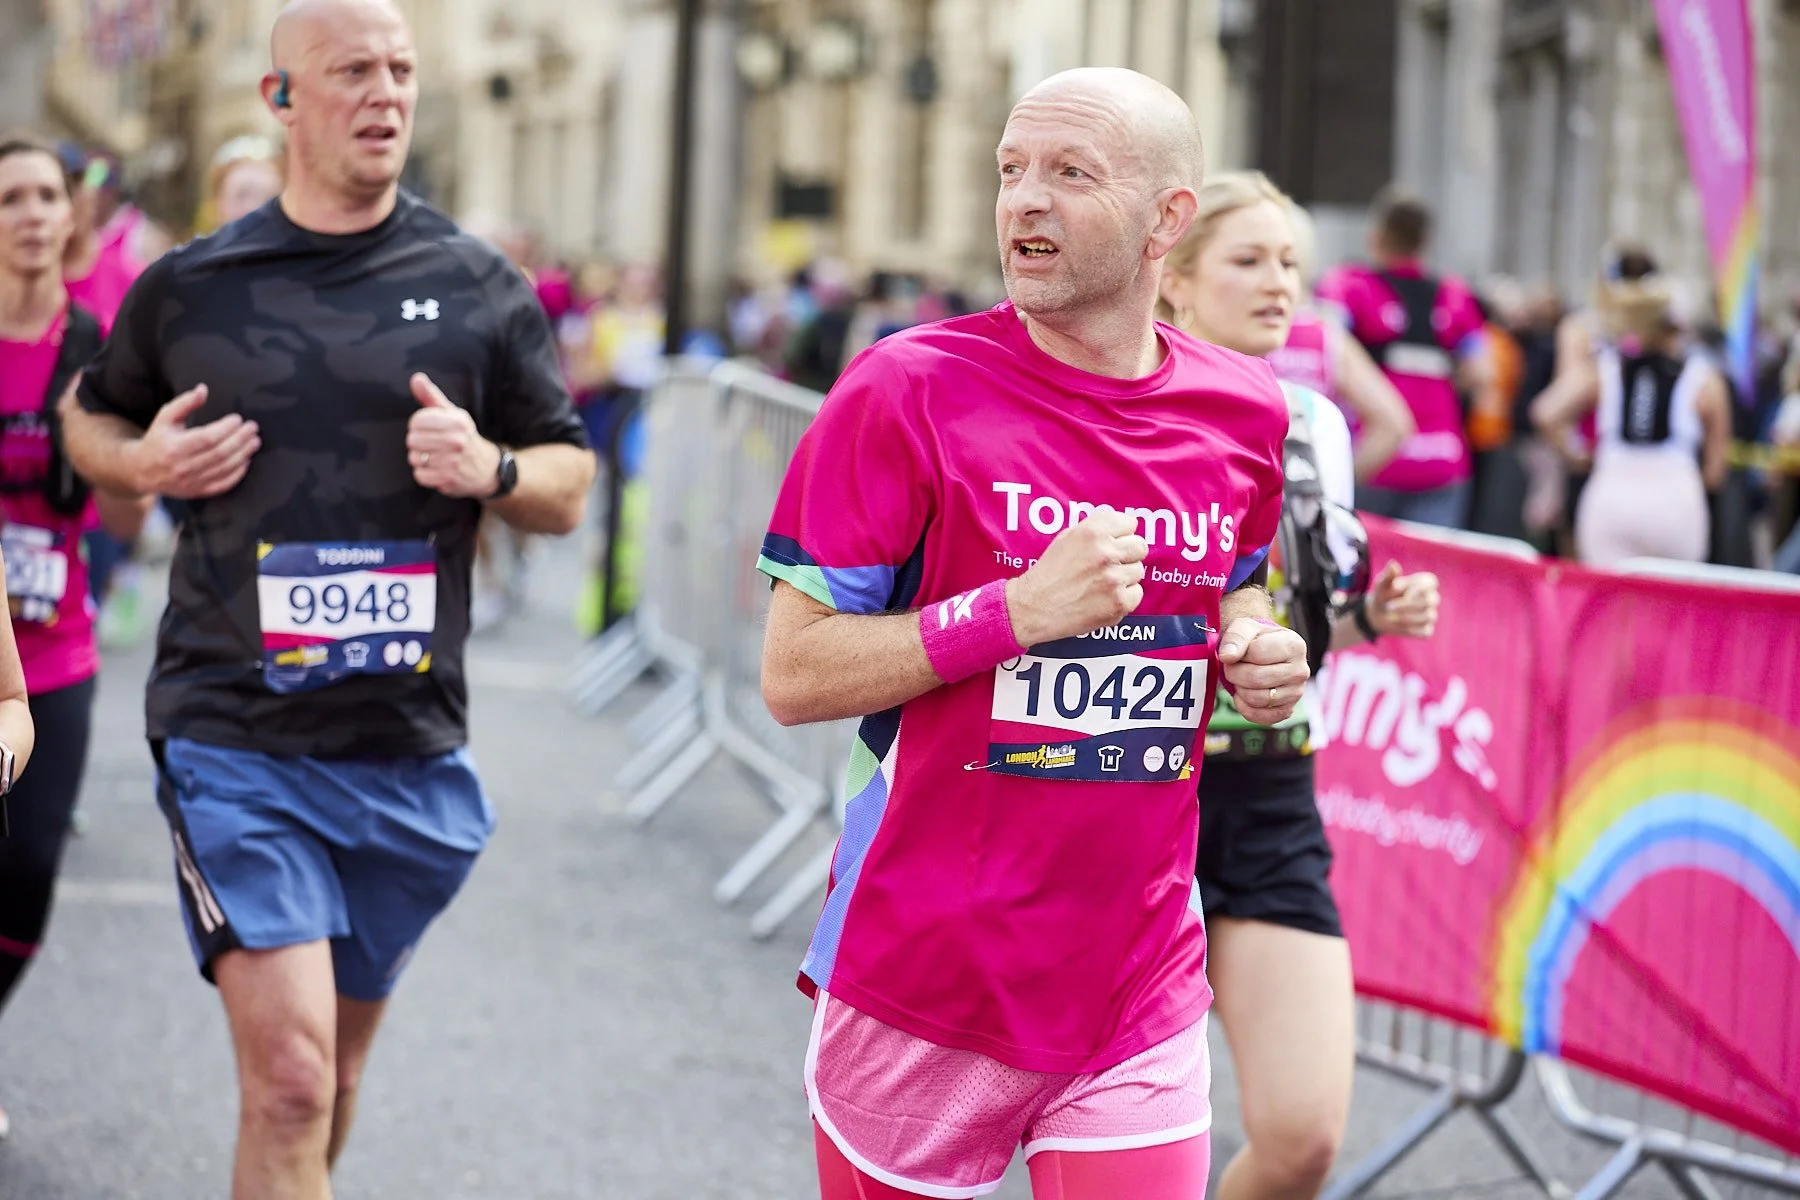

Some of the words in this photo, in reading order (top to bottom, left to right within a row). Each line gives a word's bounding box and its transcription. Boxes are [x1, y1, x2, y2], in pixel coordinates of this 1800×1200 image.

[316, 548, 385, 566] TODDINI
[992, 550, 1023, 569] The
[1151, 566, 1191, 587] baby
[288, 582, 410, 624] 9948
[1015, 661, 1196, 721] 10424
[1006, 751, 1038, 763] LONDON
[1174, 758, 1180, 766] 4
